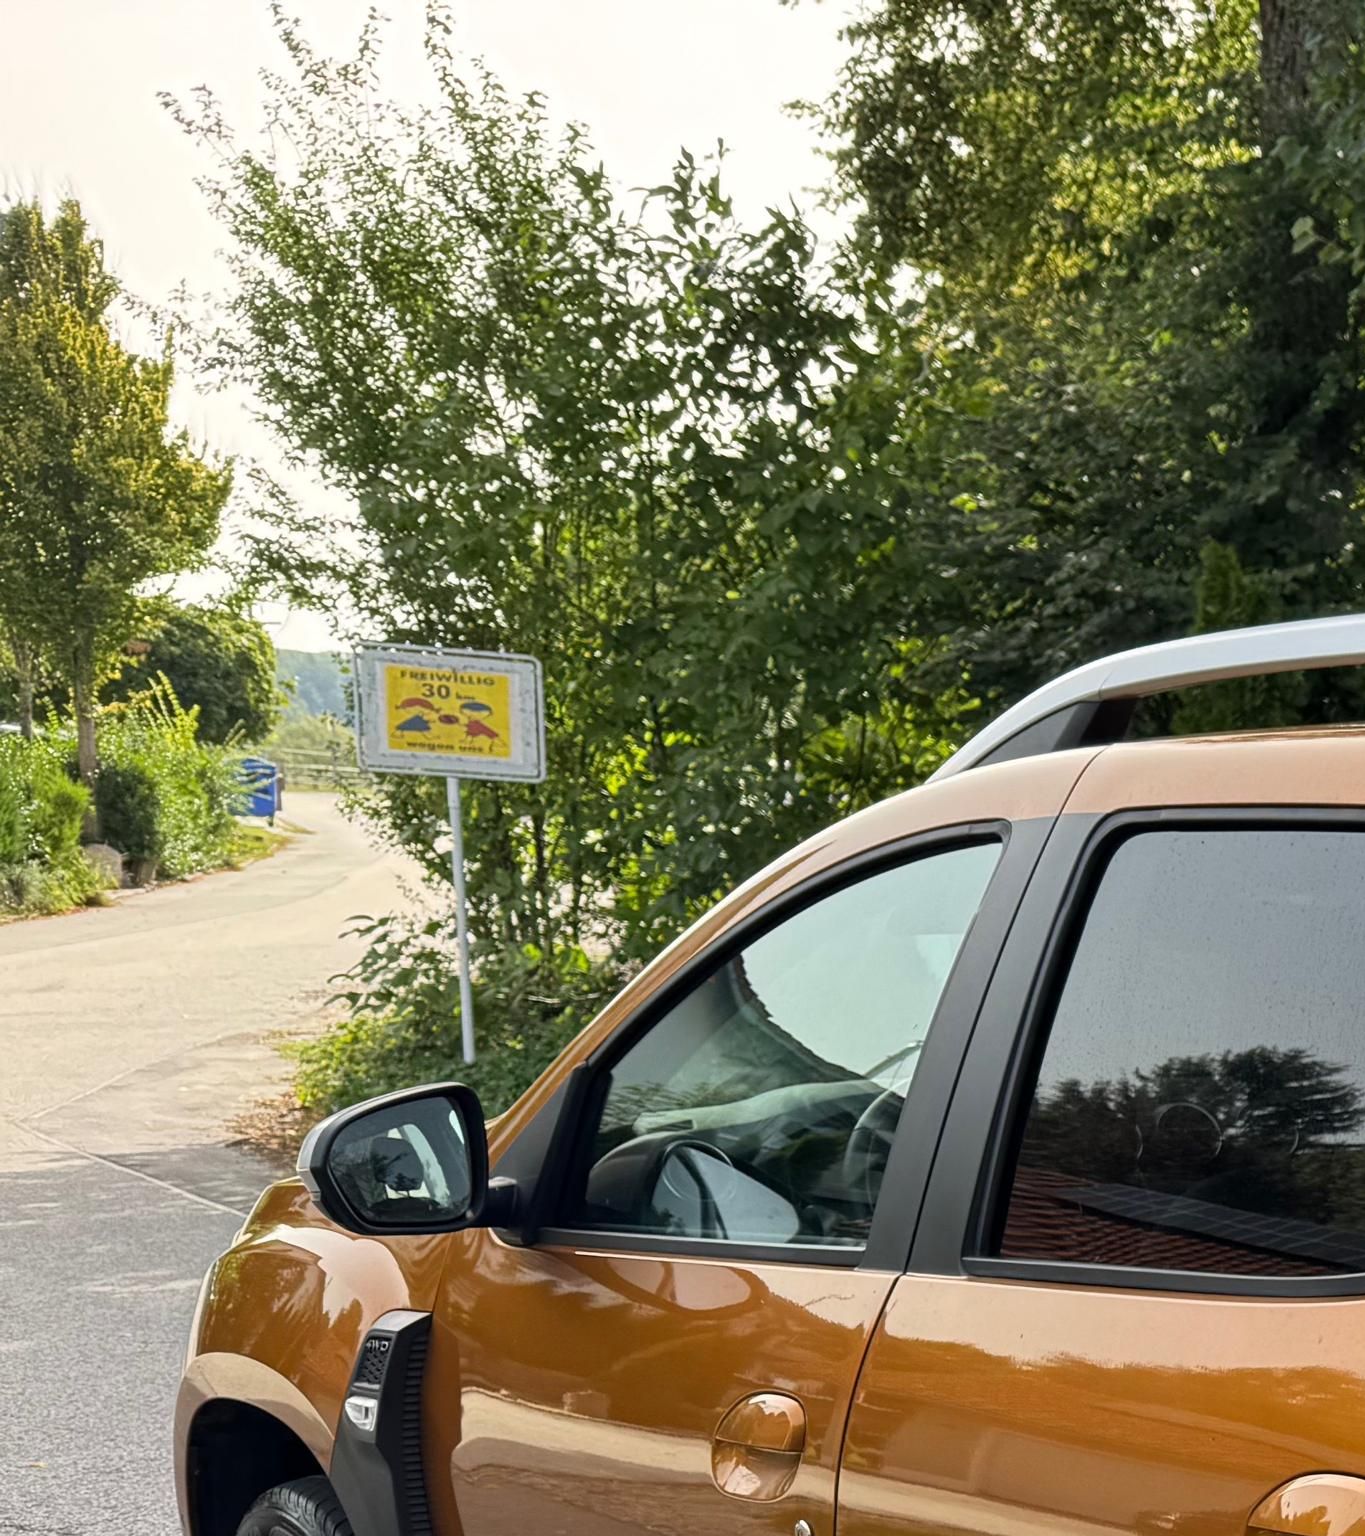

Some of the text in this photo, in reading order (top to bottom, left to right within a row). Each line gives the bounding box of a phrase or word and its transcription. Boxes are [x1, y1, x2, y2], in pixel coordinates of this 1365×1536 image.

[400, 669, 496, 686] FREIWILLIG
[421, 683, 450, 699] 30
[406, 741, 455, 752] wegen
[365, 1338, 389, 1352] 4WD
